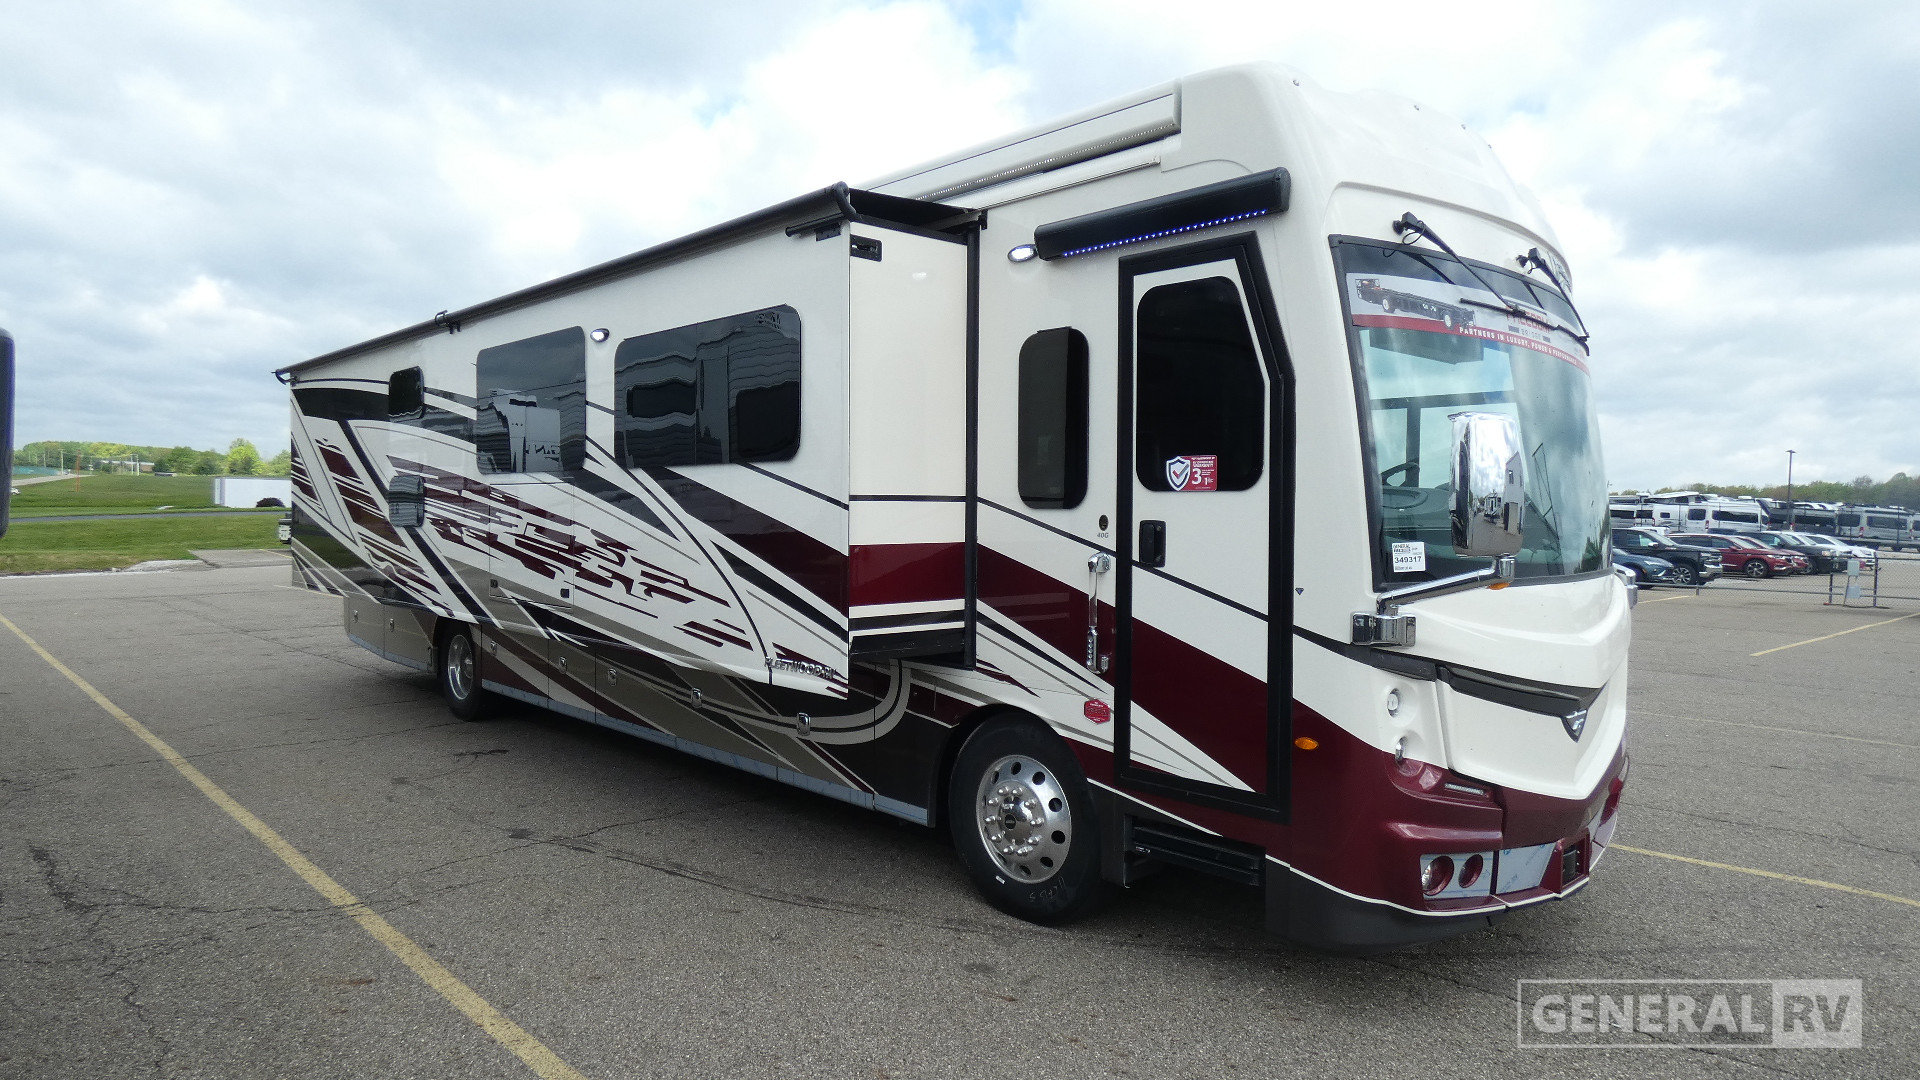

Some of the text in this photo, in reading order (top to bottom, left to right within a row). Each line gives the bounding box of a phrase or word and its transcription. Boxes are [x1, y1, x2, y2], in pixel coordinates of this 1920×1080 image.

[1459, 326, 1496, 339] PARTNERS
[1497, 333, 1505, 341] IN
[1506, 335, 1530, 348] LUXURY,
[1531, 342, 1548, 353] POWER
[1191, 468, 1202, 485] 3
[1394, 556, 1422, 564] 349317
[764, 657, 822, 677] FLEETWOOD
